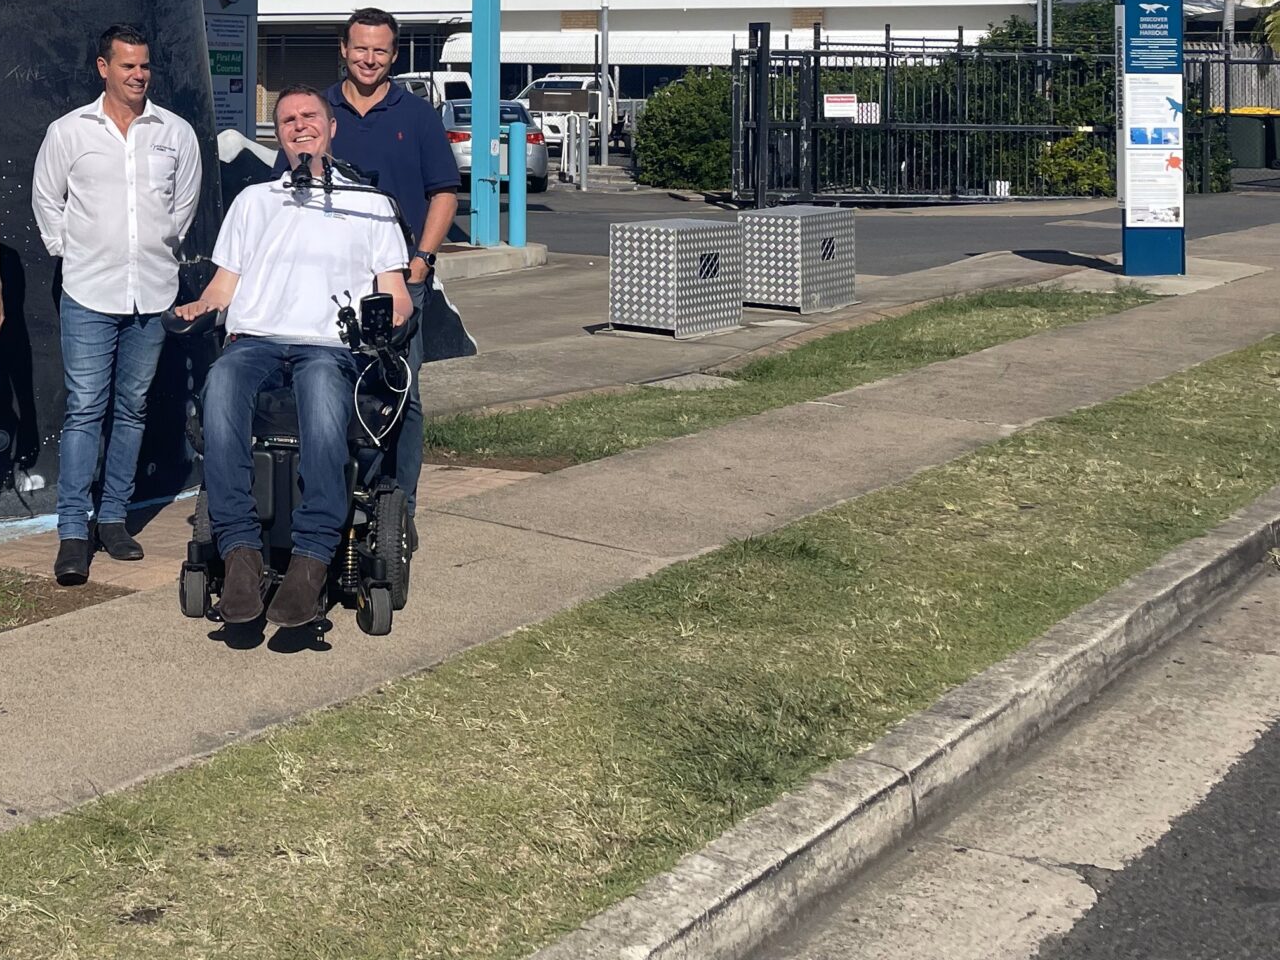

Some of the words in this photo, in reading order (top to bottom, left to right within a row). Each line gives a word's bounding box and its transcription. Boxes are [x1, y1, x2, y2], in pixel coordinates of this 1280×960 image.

[217, 53, 230, 61] First
[231, 54, 242, 62] Aid
[216, 63, 241, 73] Courses
